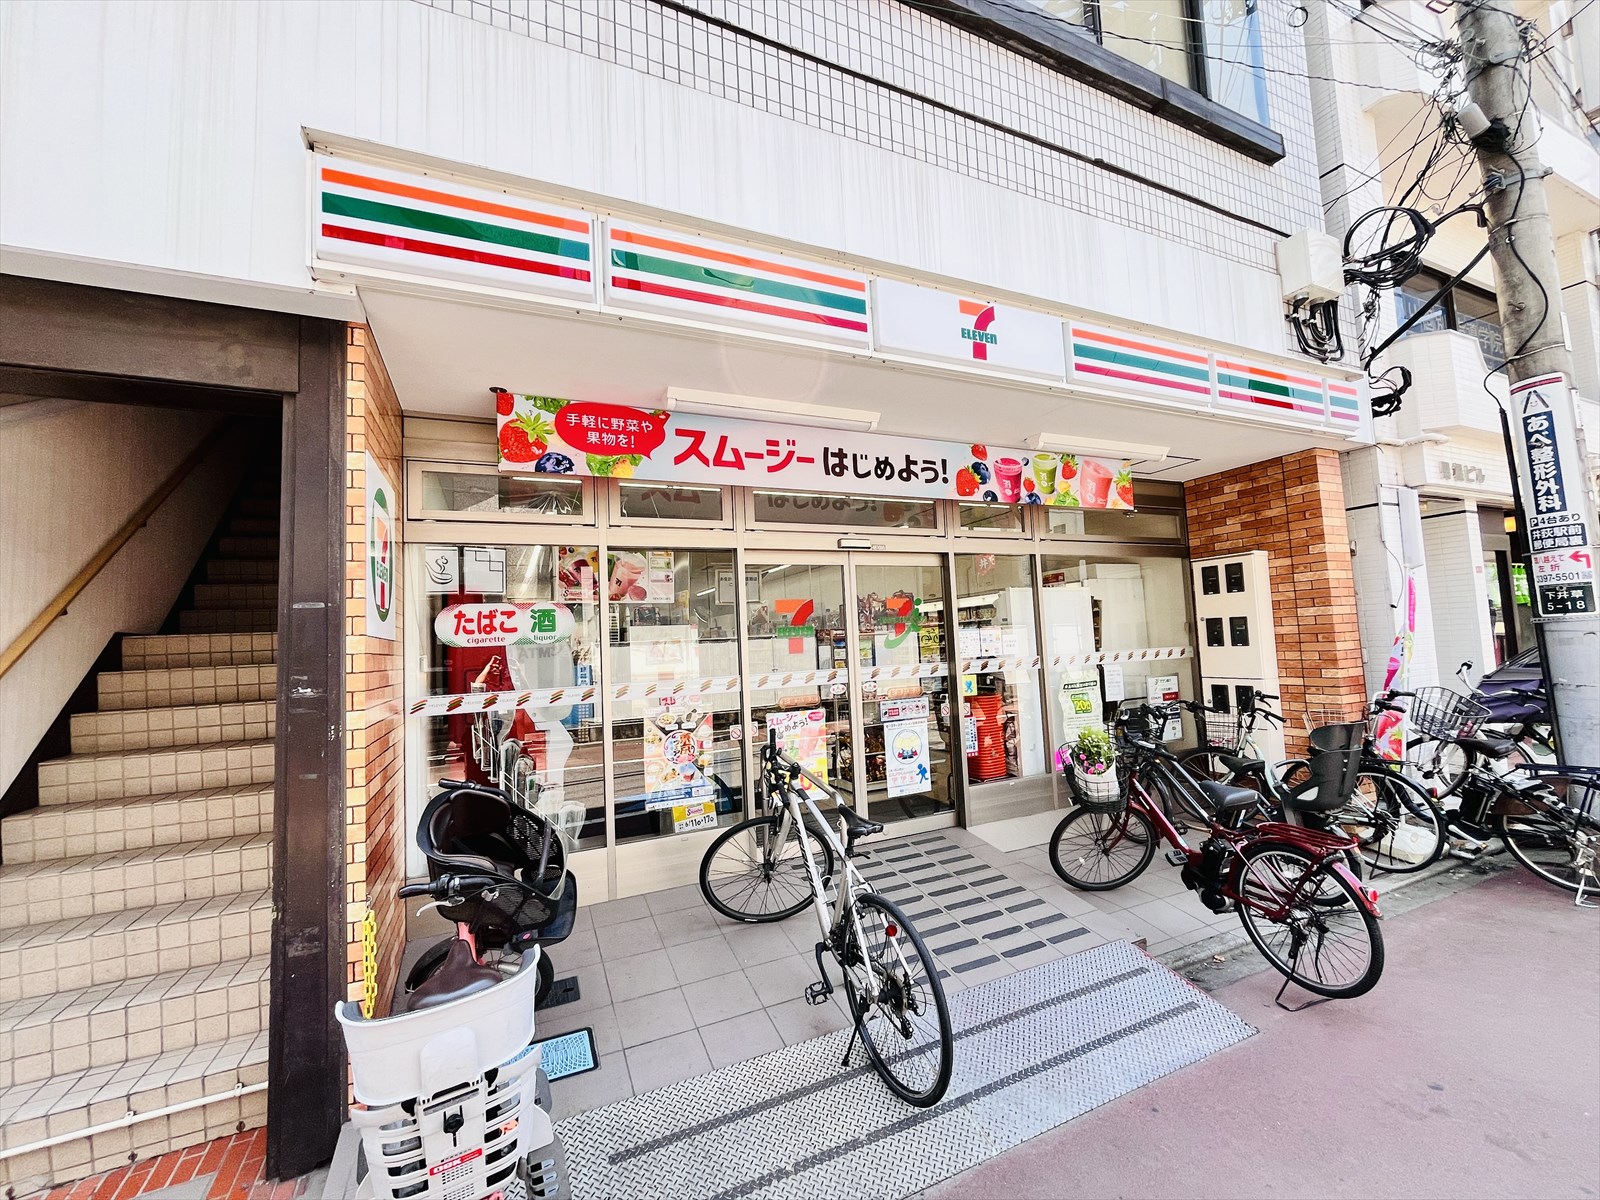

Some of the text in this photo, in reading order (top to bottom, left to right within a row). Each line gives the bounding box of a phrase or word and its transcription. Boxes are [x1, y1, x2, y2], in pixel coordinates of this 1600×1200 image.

[566, 413, 653, 433] 手軽に野菜や
[586, 431, 635, 448] 果物を!
[673, 428, 949, 484] スムージー はじめよう!
[1526, 415, 1562, 512] あべ整形外科
[1532, 525, 1582, 540] 井荻駅前
[1545, 589, 1584, 600] 下井草
[1547, 600, 1586, 611] 5-18
[453, 608, 557, 636] たばこ 酒
[466, 634, 557, 645] cigarette liquor
